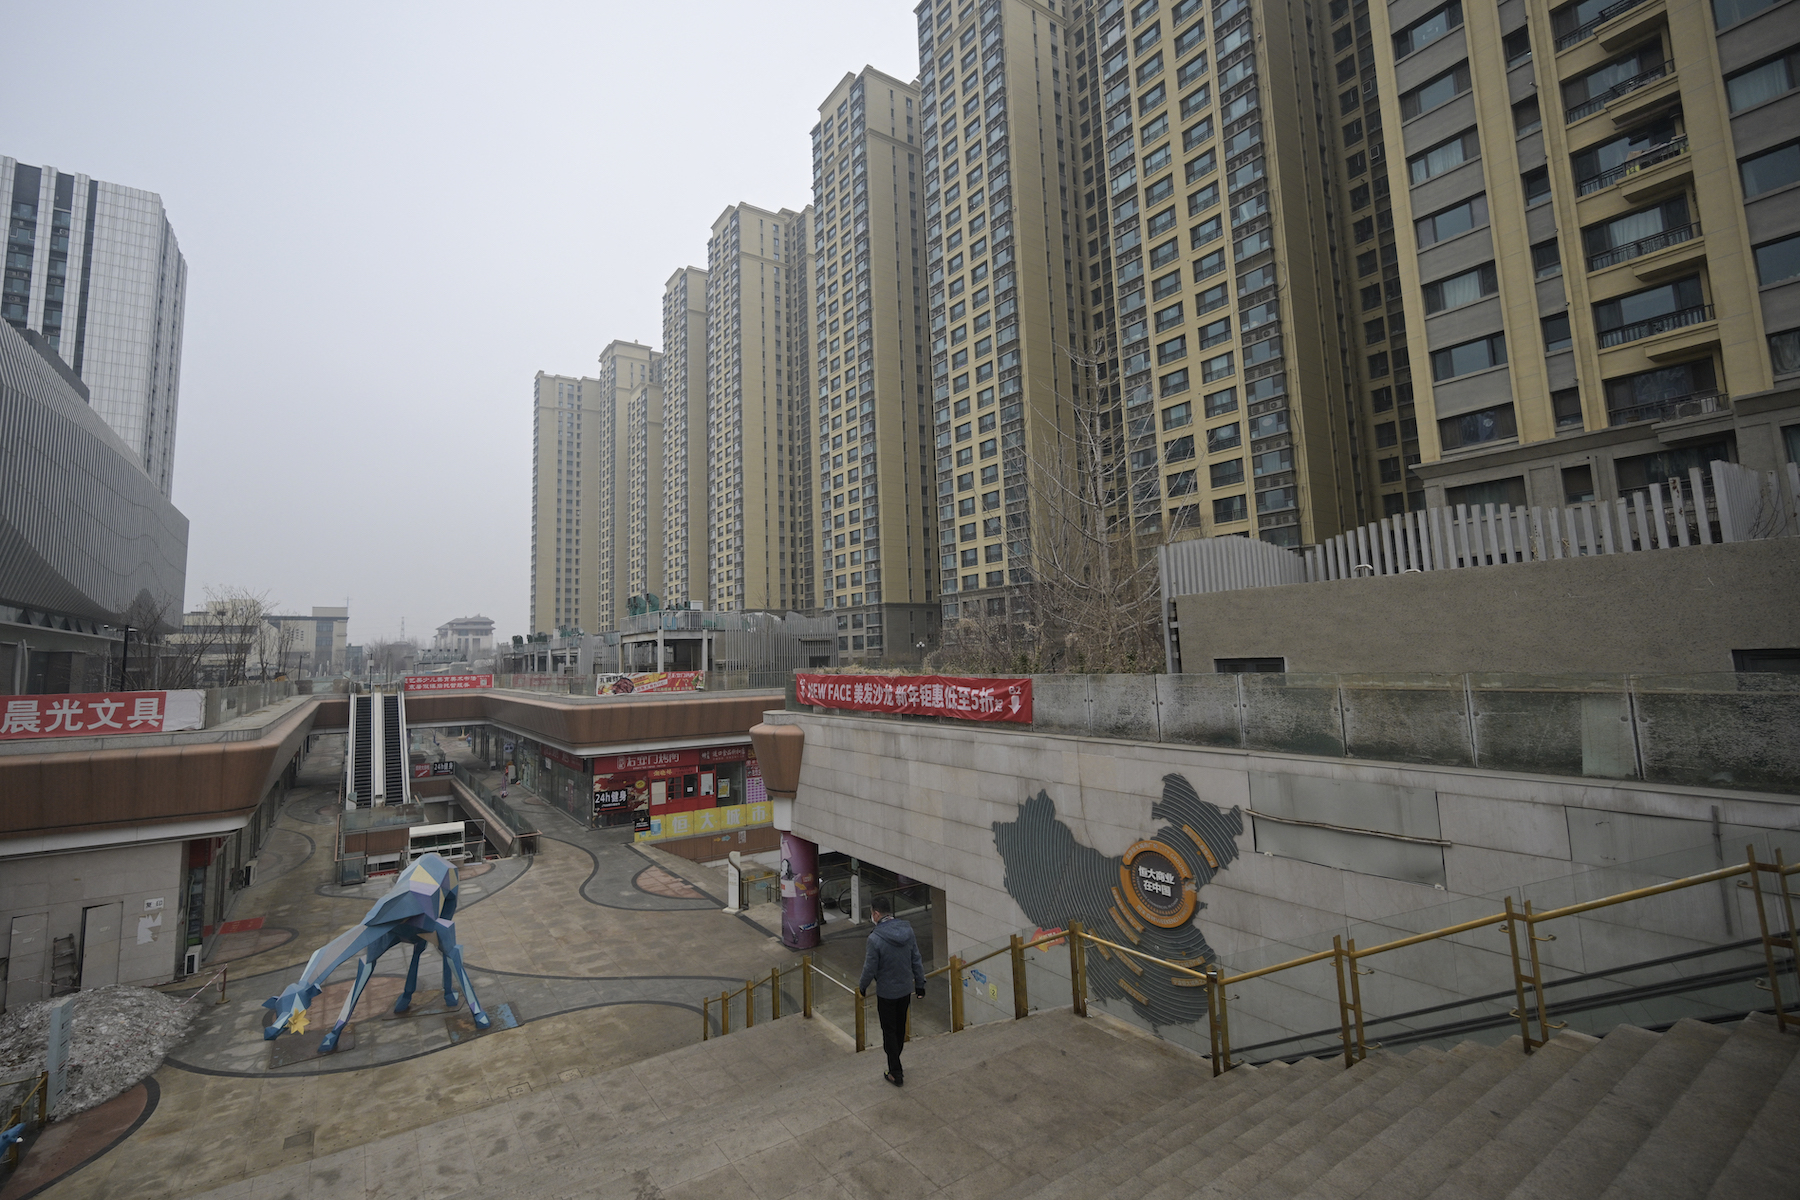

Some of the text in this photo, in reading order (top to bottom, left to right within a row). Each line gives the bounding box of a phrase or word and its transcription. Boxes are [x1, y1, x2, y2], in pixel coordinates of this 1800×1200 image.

[807, 683, 852, 701] NEW FACE
[854, 682, 894, 706] 美发沙龙
[1008, 686, 1022, 695] B2
[0, 698, 163, 734] 晨光文具
[595, 790, 627, 803] 24h健身
[672, 805, 766, 834] 恒大城市
[1170, 853, 1188, 876] GROUND
[1138, 866, 1175, 885] 恒大商业
[1143, 880, 1171, 897] 在中国
